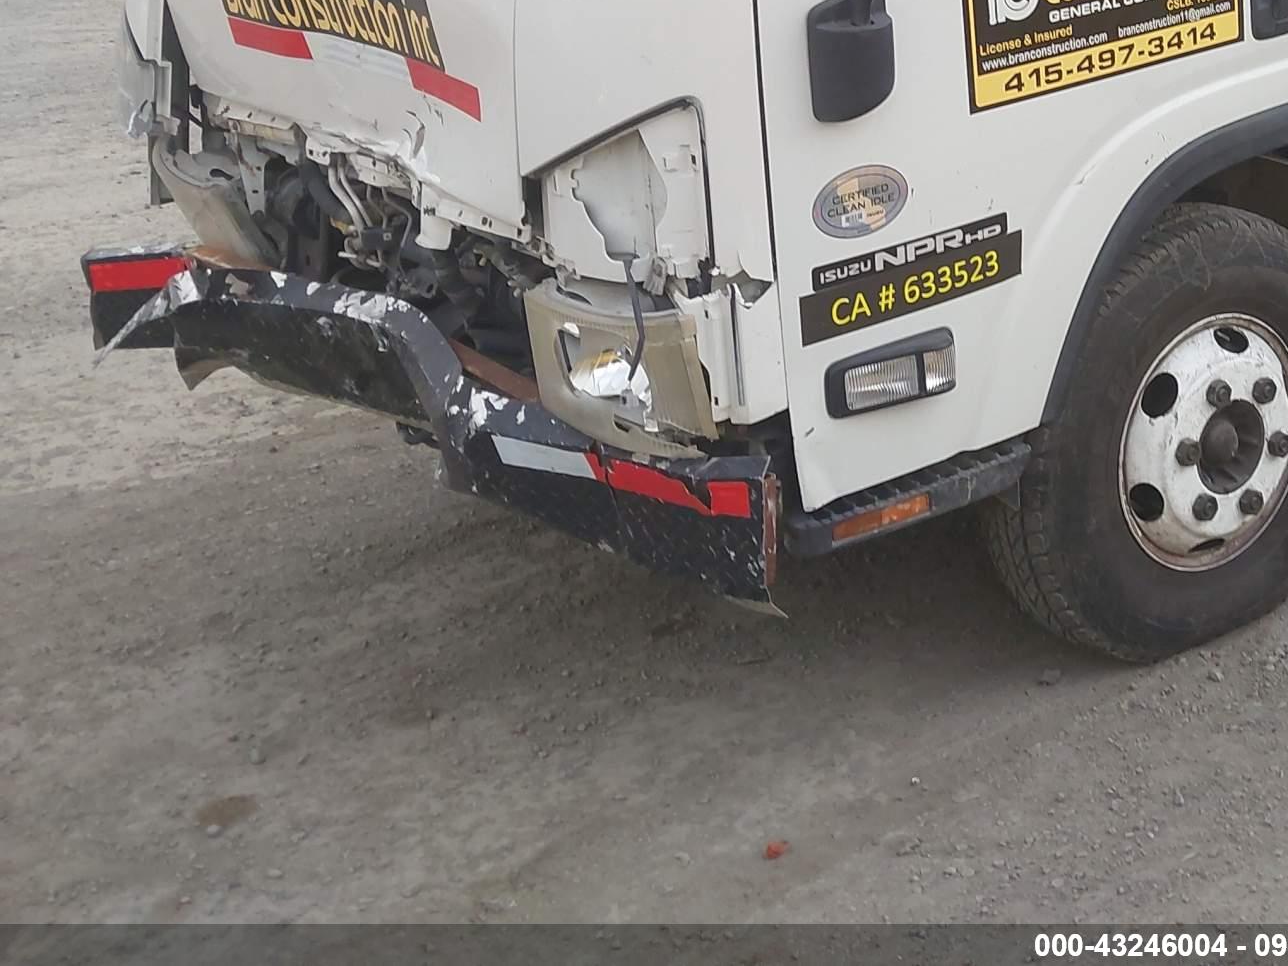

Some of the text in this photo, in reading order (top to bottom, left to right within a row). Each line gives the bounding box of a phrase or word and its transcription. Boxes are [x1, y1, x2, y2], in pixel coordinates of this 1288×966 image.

[981, 32, 1108, 72] www.branconstruction.com
[1023, 33, 1033, 47] &
[1034, 24, 1073, 44] Insured
[1004, 22, 1216, 93] 415-497-3414
[827, 201, 866, 218] CLEAN
[870, 193, 895, 207] IDLE
[832, 183, 889, 206] CERTIFIED
[820, 224, 1001, 284] ISUZU NPR HD
[832, 250, 999, 325] CA # 633523
